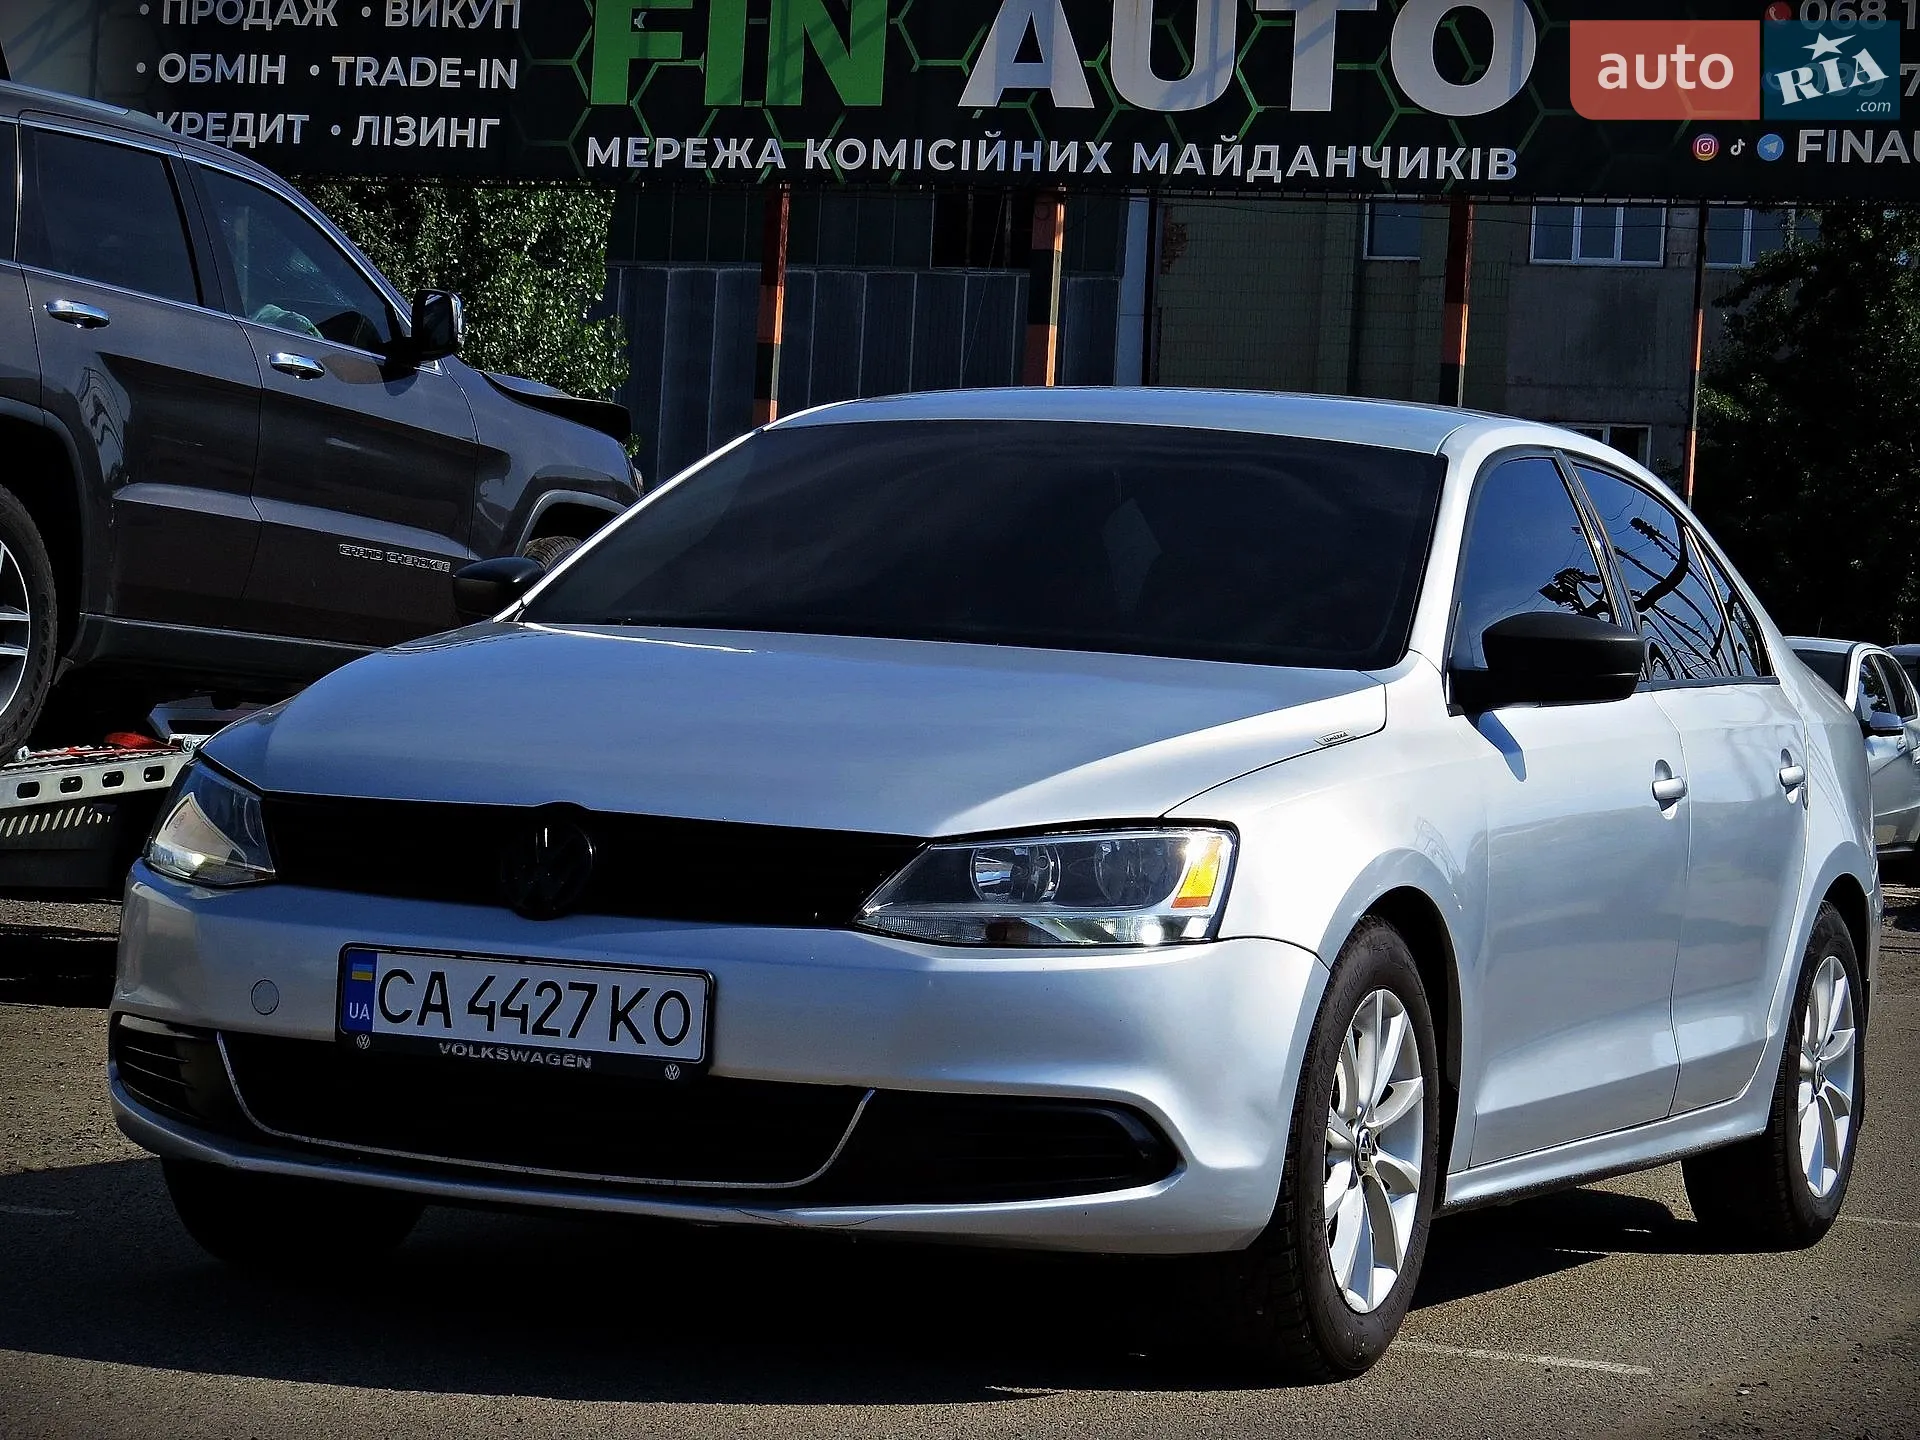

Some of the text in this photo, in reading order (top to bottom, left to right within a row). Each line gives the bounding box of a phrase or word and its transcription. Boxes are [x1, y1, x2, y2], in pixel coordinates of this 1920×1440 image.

[162, 0, 338, 31] ПРОДАЖ
[385, 0, 521, 30] ВИКУП
[1800, 0, 1887, 30] 068
[158, 53, 286, 84] ОБМІН
[332, 56, 518, 90] TRADE-IN
[590, 0, 1537, 117] FIN AUTO
[352, 115, 500, 148] ЛІЗИНГ
[1797, 129, 1920, 164] FINA
[586, 131, 1518, 184] МЕРЕЖА КОМІСІЙНИХ МАЙДАНЧИКІВ
[349, 1002, 370, 1021] UA
[378, 968, 453, 1029] CA
[467, 975, 598, 1040] 4427
[438, 1041, 593, 1070] VOLKSWAGEN
